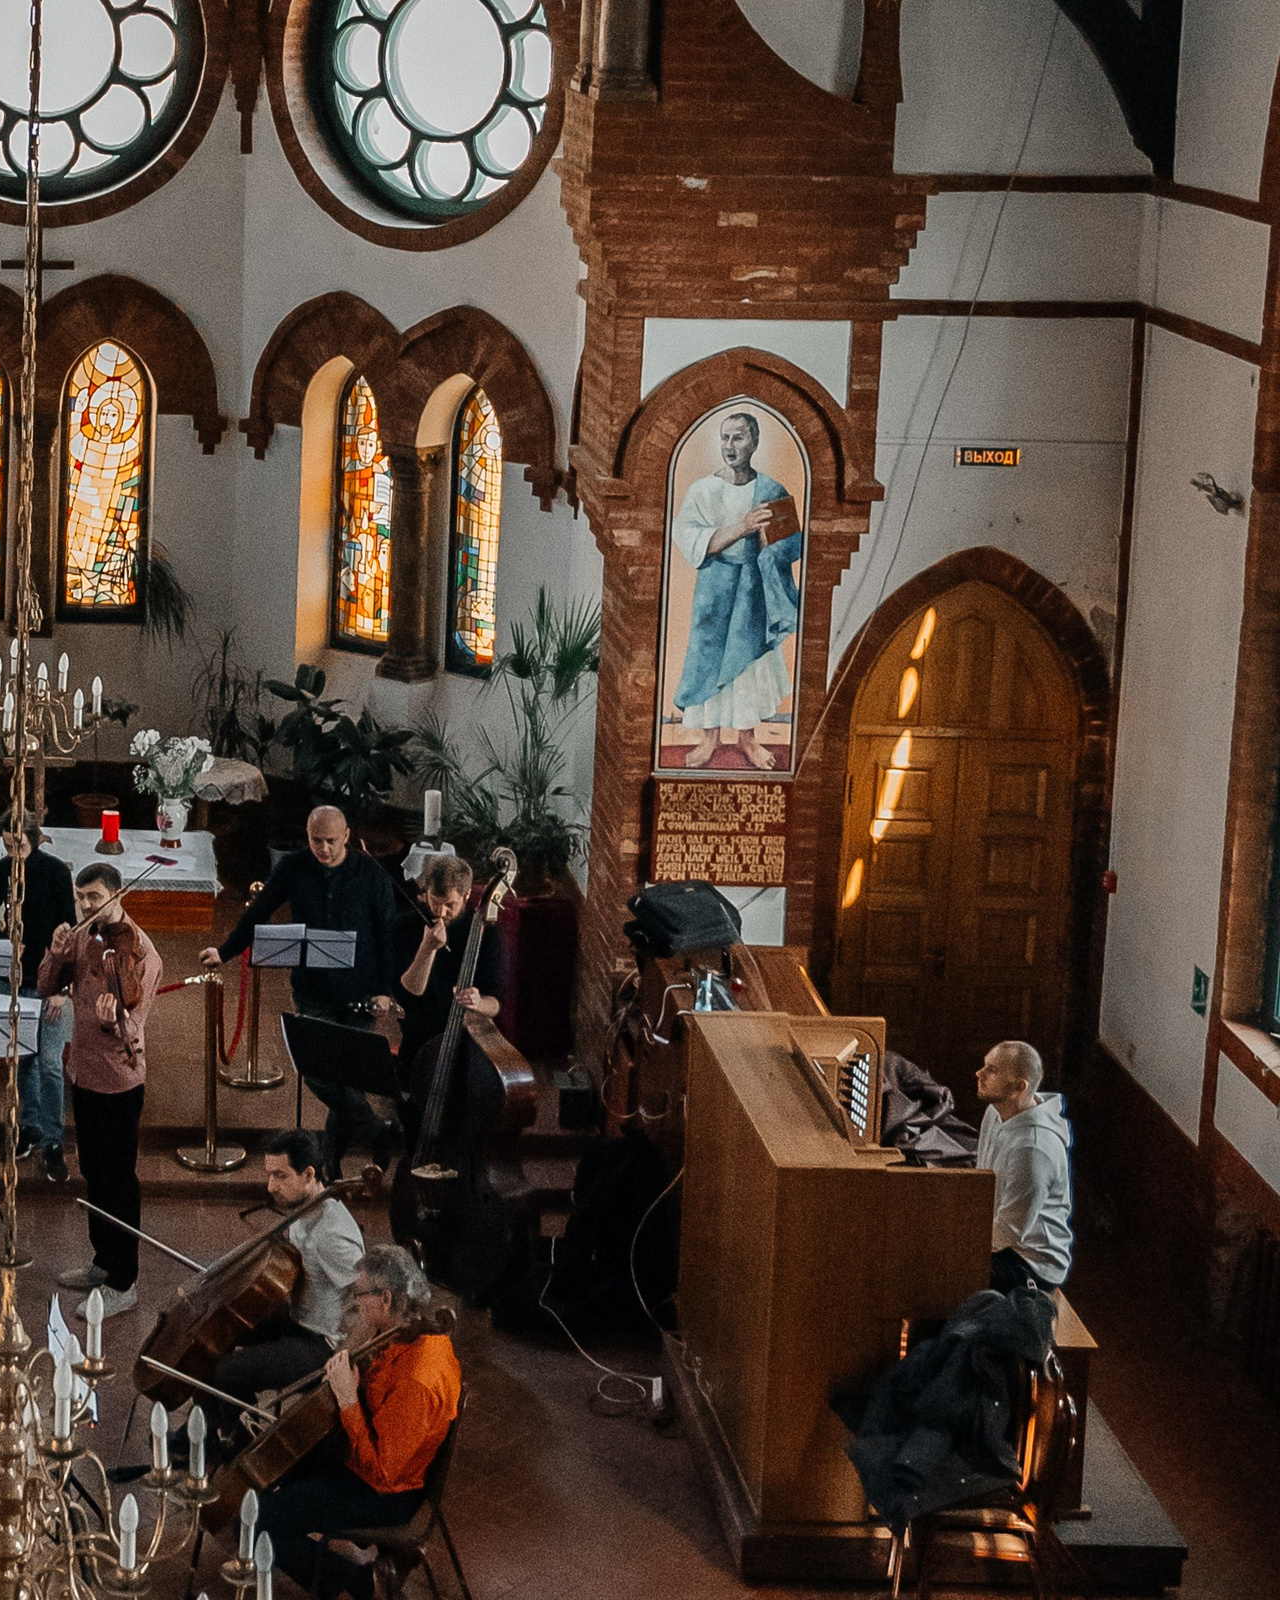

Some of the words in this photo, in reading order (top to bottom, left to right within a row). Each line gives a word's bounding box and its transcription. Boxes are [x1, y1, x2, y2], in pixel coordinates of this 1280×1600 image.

[964, 450, 1013, 465] ВЫХОД
[659, 783, 674, 793] НЕ
[727, 784, 768, 795] ЧТОБЫ
[773, 785, 782, 795] Я
[737, 794, 752, 803] НО
[740, 804, 785, 814] ДОСТИГ
[658, 811, 692, 821] МЕНЯ
[657, 821, 665, 831] К
[656, 844, 686, 853] IFFEN
[719, 845, 734, 854] ICH
[715, 854, 739, 864] WEIL
[742, 854, 759, 865] ICH
[763, 855, 785, 865] VON
[656, 862, 706, 872] CHRISTUS
[710, 863, 743, 873] JESUS
[655, 871, 686, 881] FFEN
